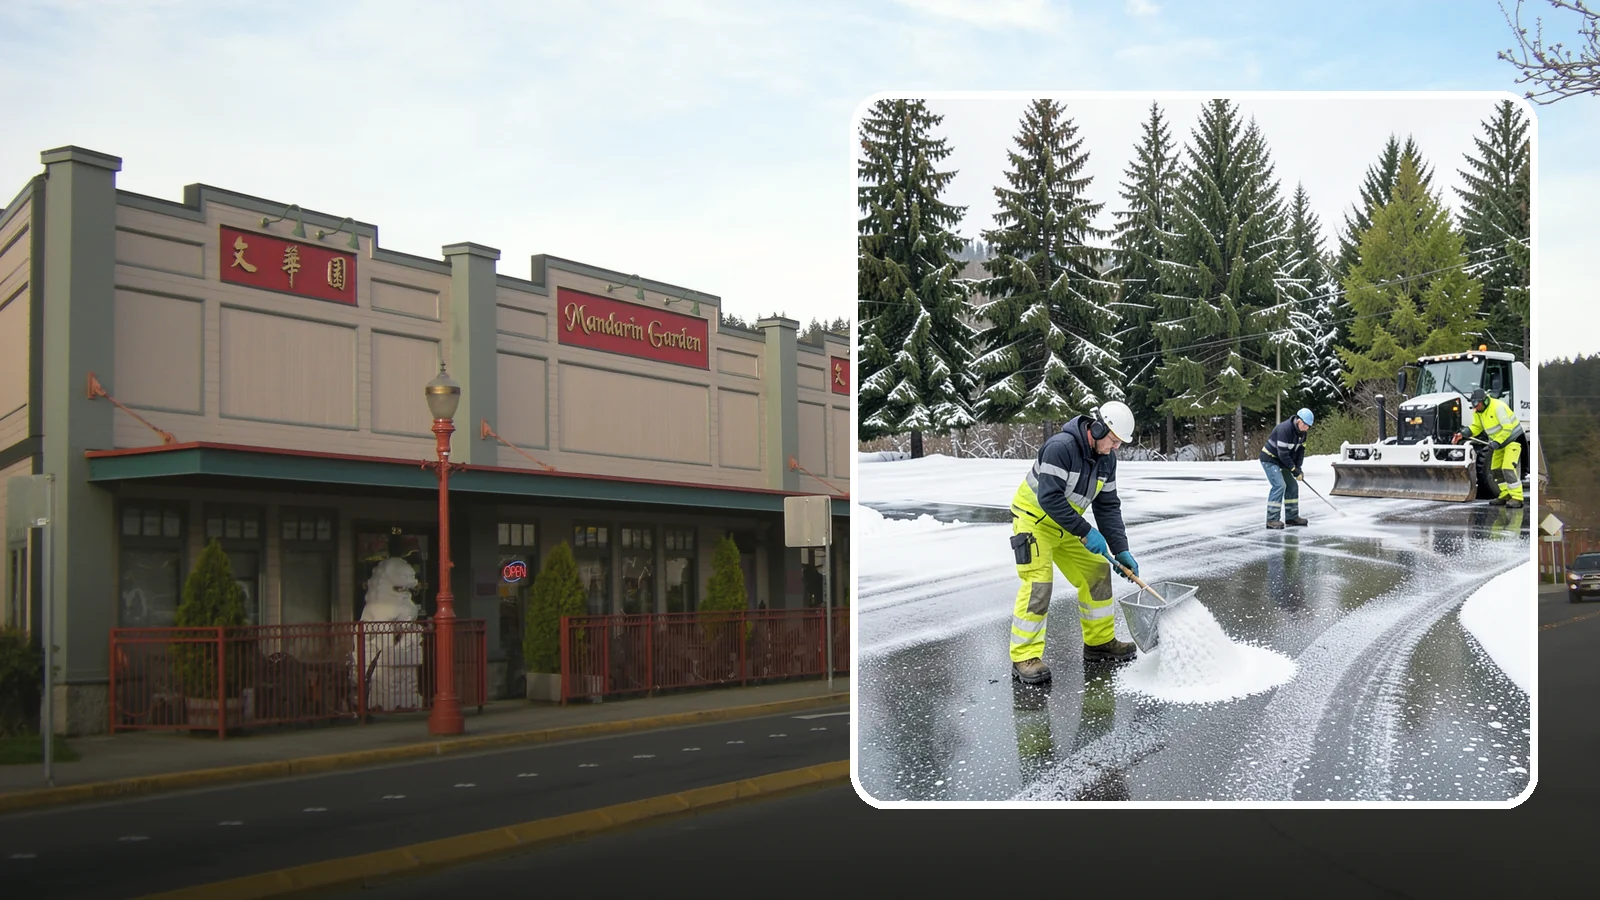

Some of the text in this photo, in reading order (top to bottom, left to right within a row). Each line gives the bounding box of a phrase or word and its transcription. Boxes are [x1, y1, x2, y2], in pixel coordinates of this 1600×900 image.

[231, 236, 346, 291] 文華園
[565, 302, 702, 352] Mandarin Garden
[503, 565, 527, 578] OPEN
